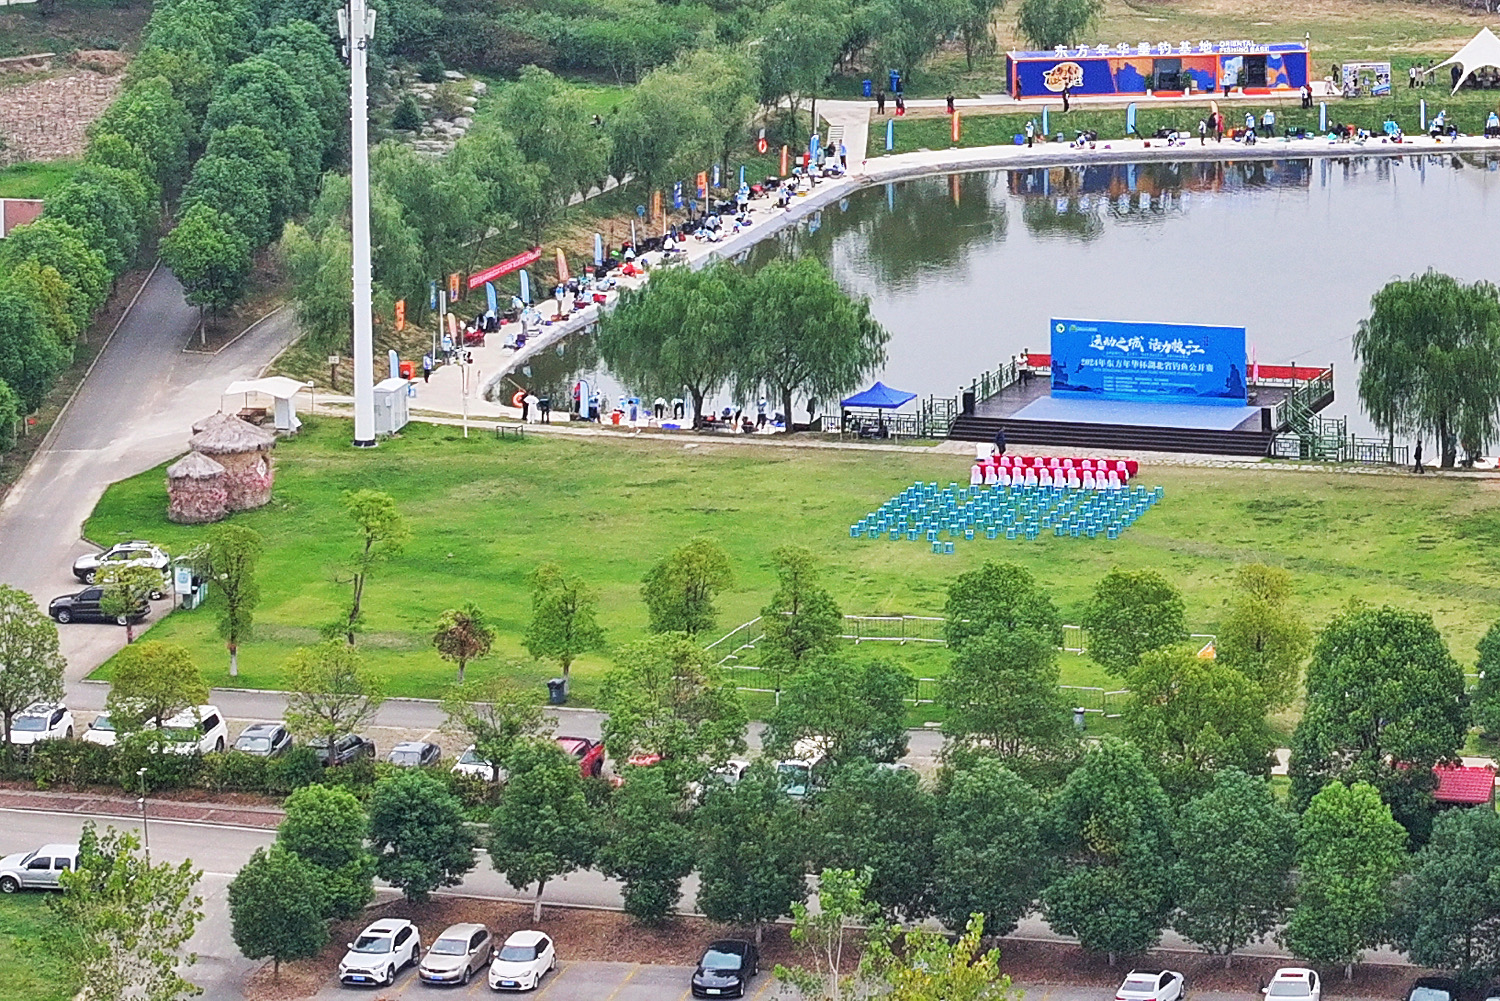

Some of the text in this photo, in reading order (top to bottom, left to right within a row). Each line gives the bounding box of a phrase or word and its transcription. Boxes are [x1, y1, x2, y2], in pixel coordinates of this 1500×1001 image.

[1054, 40, 1213, 58] 东方年华垂钓基地
[1089, 334, 1205, 356] 运动之城 活力枝江
